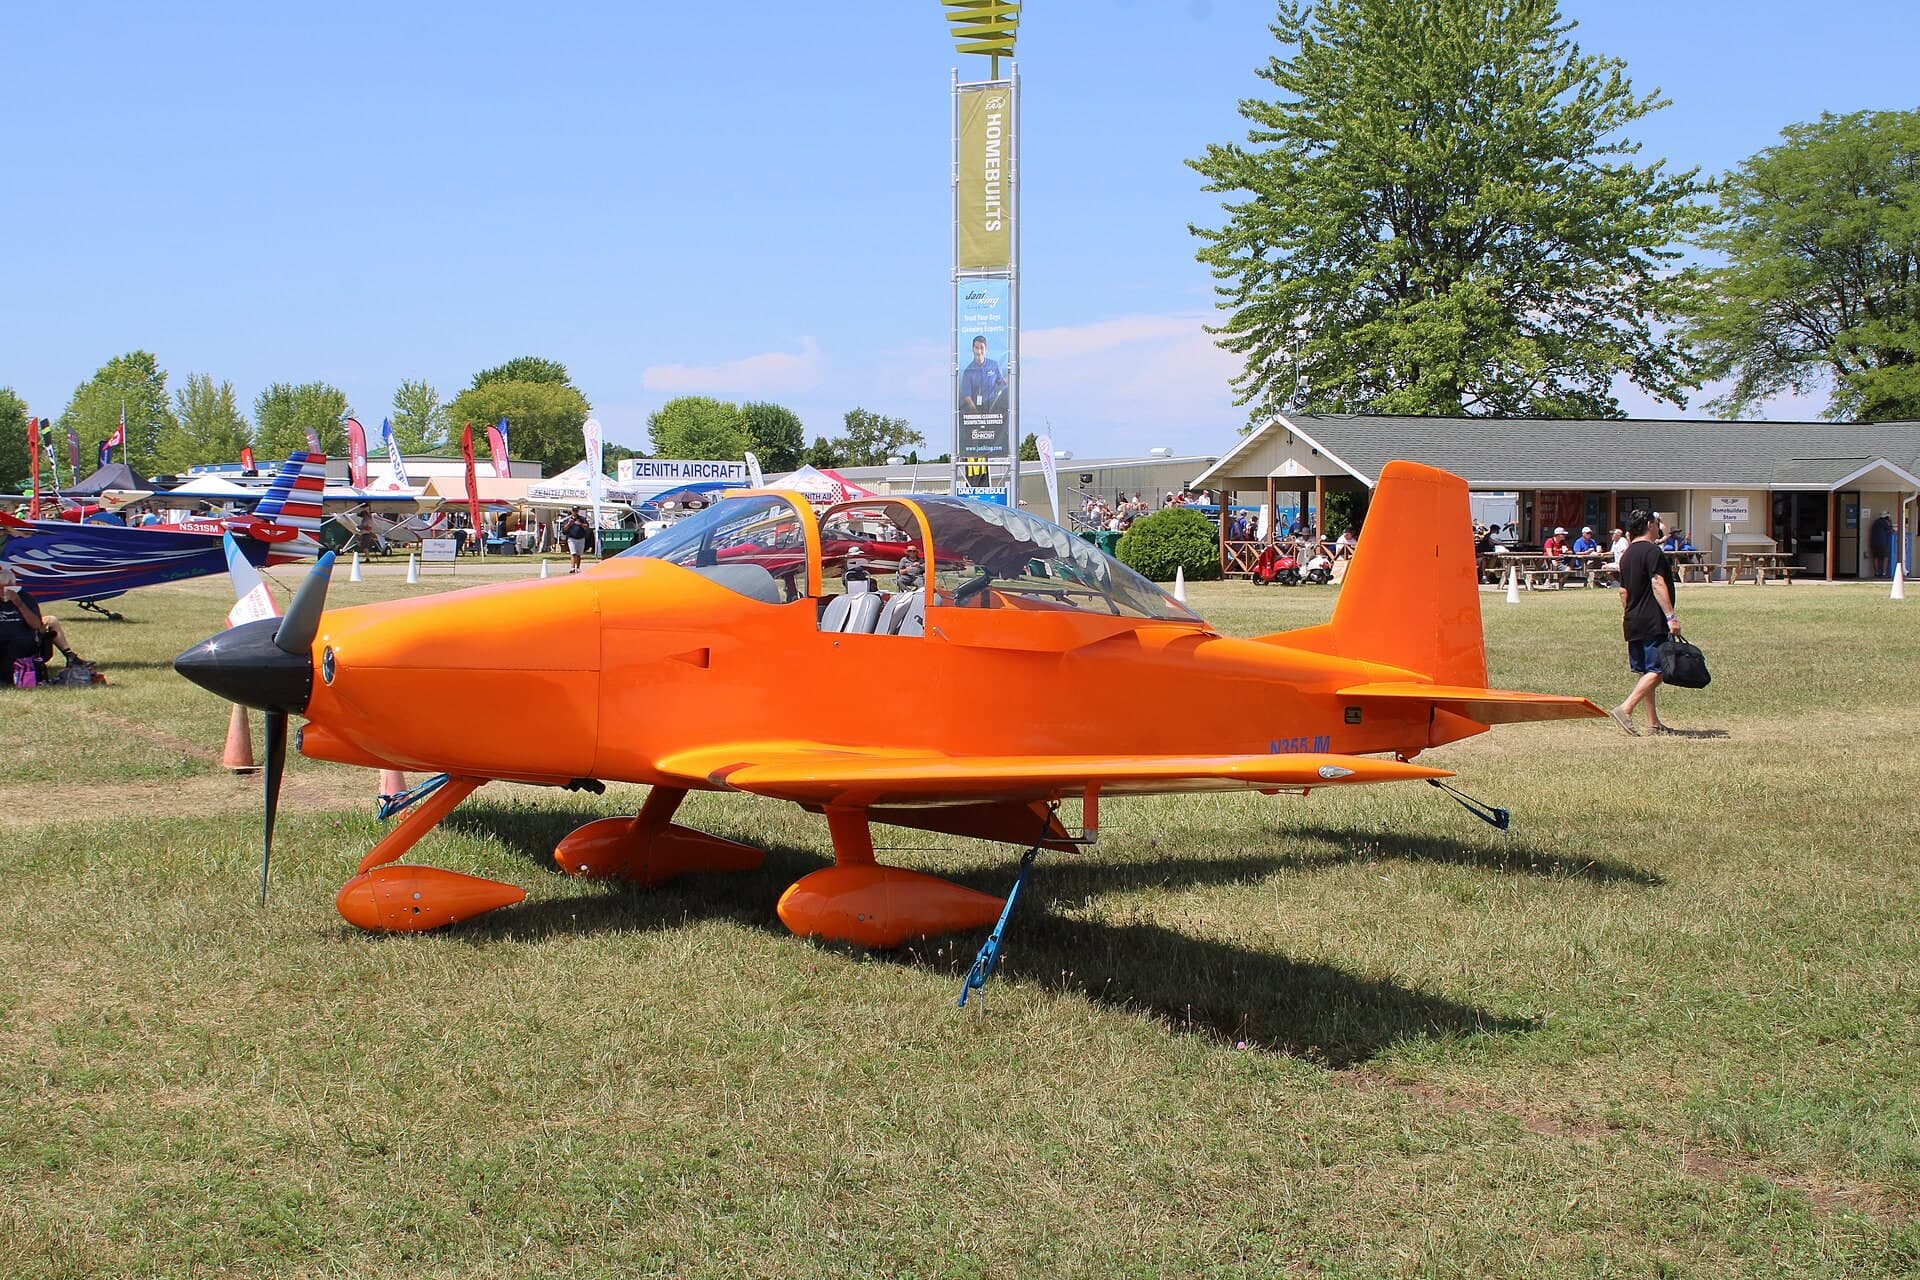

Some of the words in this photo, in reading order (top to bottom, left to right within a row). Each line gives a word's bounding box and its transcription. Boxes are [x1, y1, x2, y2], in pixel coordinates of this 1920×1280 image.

[985, 113, 1001, 231] HOMEBUILTS
[965, 290, 985, 300] Jani
[635, 462, 679, 477] ZENITH
[682, 463, 742, 478] AIRCRAFT
[179, 522, 219, 533] N531SM
[1269, 736, 1330, 754] N355JM
